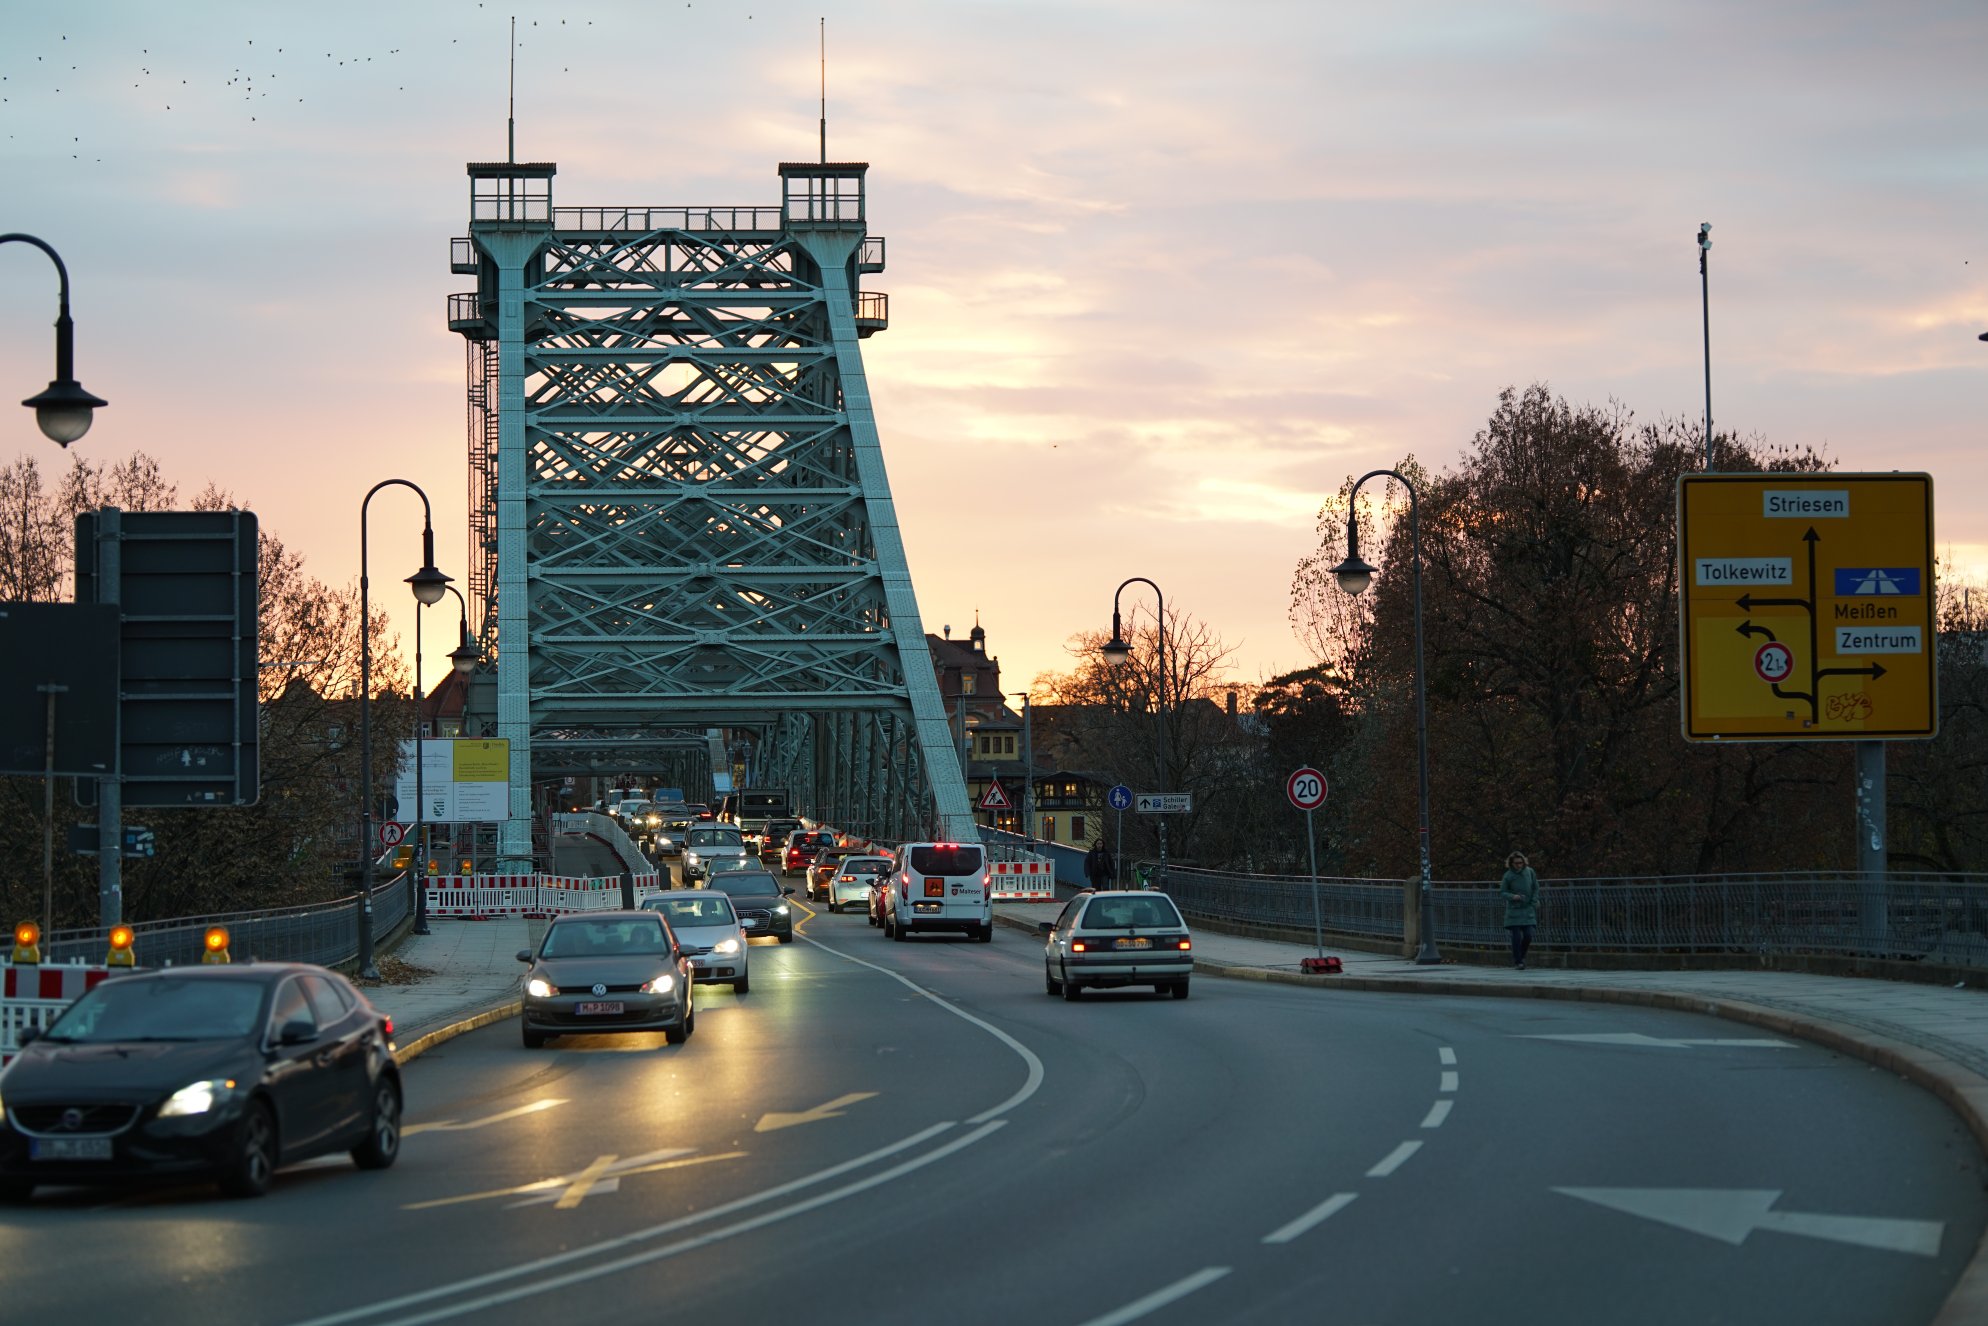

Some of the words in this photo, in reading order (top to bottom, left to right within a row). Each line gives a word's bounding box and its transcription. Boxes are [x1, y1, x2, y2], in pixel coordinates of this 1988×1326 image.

[1769, 496, 1844, 513] Striesen
[1702, 563, 1787, 580] Tolkewitz
[1834, 604, 1898, 619] Meißen
[1841, 632, 1917, 649] Zentrum
[1296, 779, 1319, 799] 20
